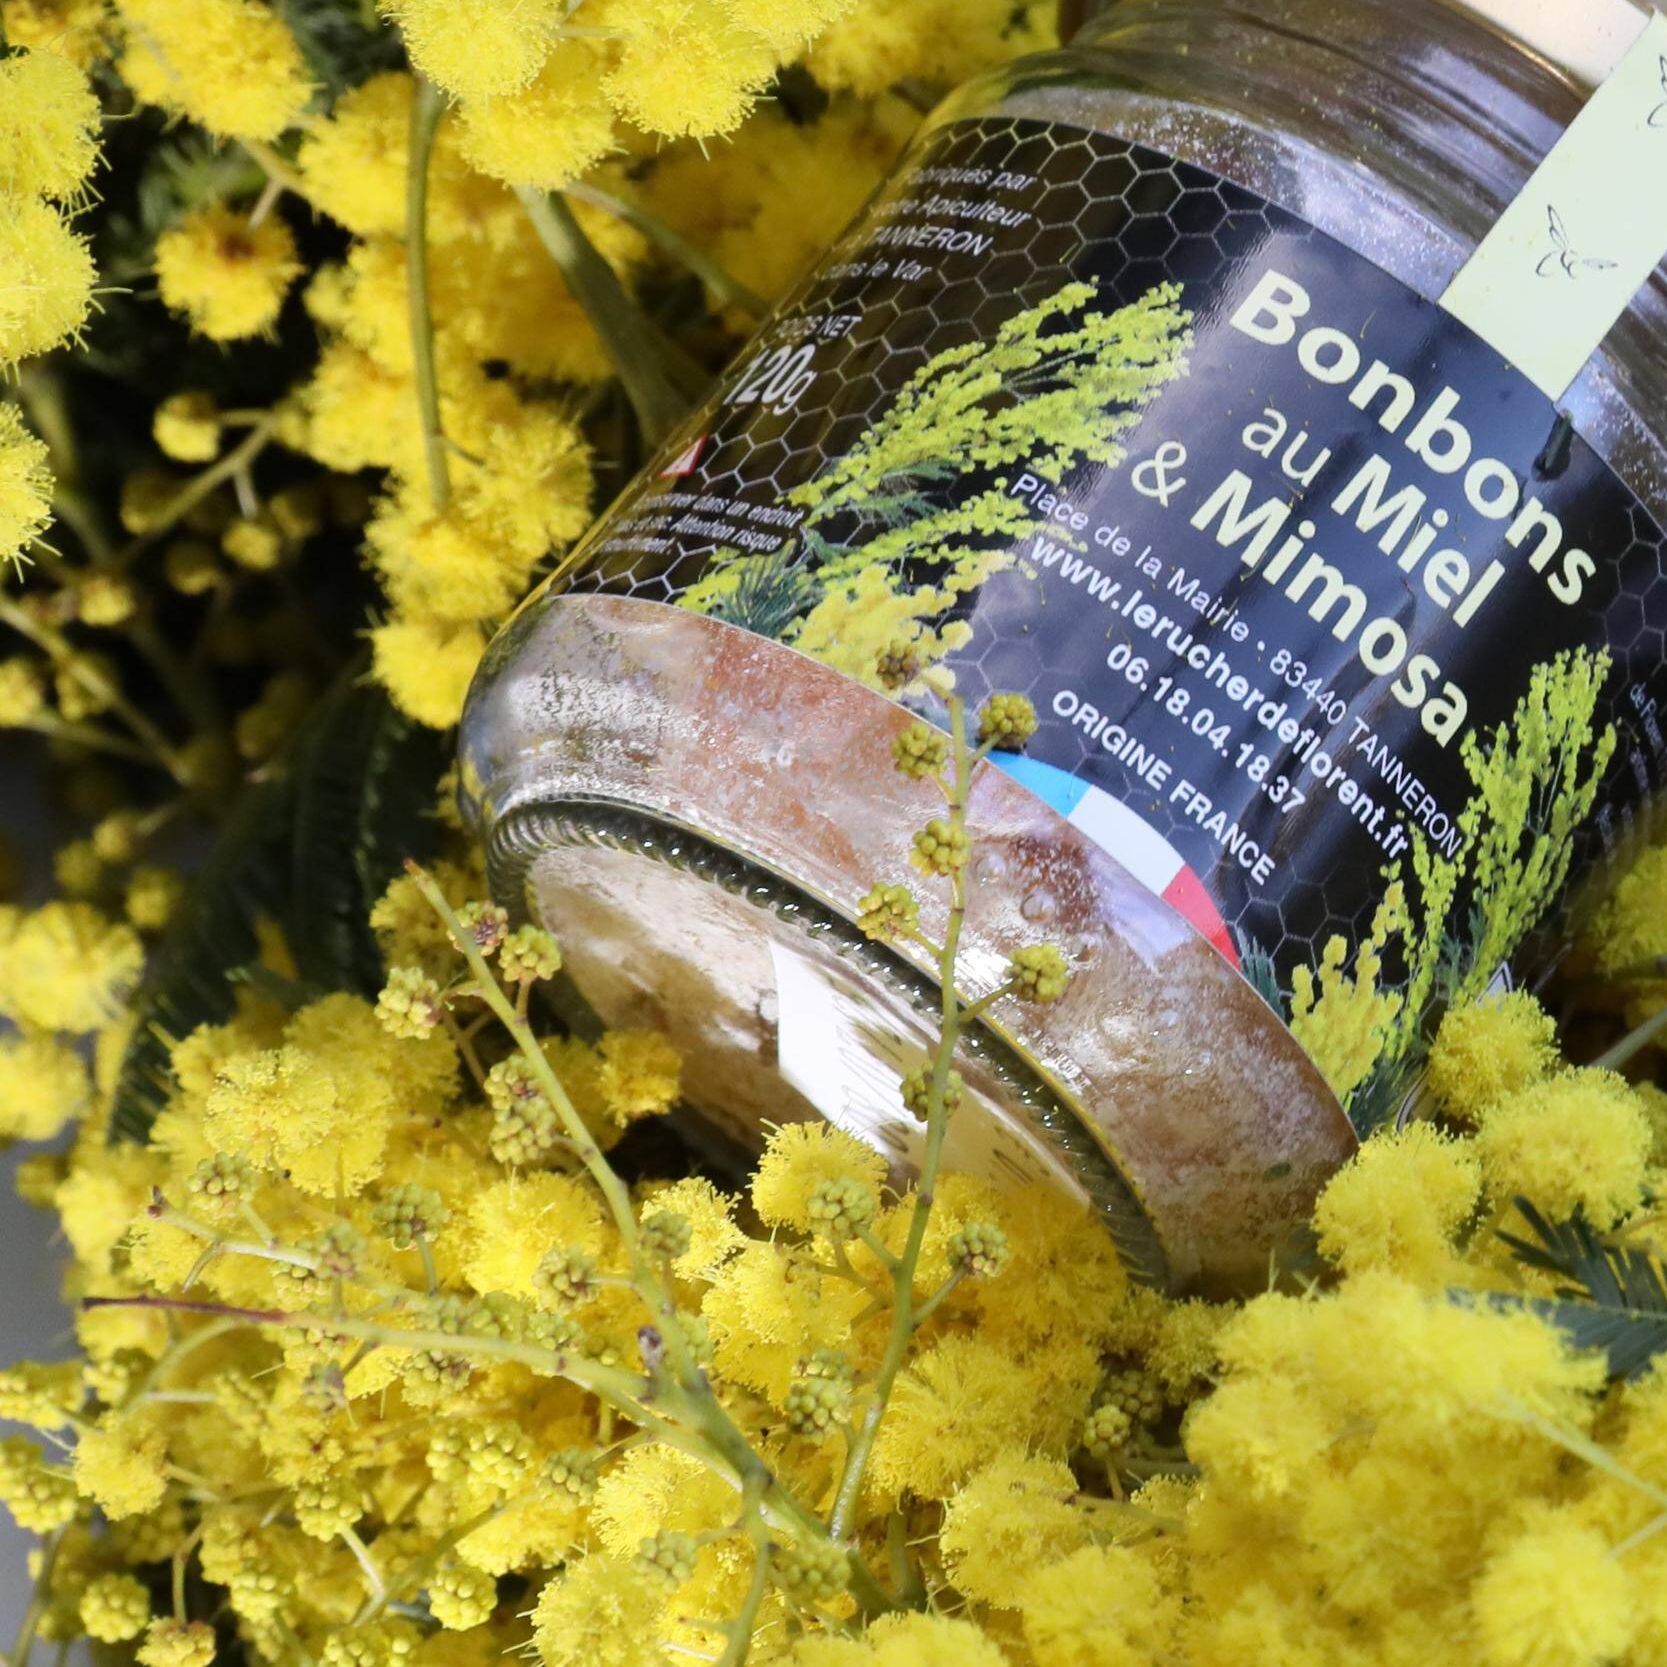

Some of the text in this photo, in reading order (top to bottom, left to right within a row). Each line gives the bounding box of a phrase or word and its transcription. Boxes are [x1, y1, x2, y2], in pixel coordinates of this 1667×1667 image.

[915, 193, 1032, 229] Apiculteur
[986, 170, 1038, 192] par
[866, 225, 993, 257] TANNERON
[866, 257, 889, 278] le
[892, 257, 933, 281] Var
[816, 315, 863, 338] NET
[722, 343, 818, 417] 120g
[1229, 269, 1596, 606] Bonbons
[669, 512, 737, 541] Attention
[731, 525, 783, 555] risque
[692, 491, 730, 513] dans
[726, 499, 750, 518] un
[747, 503, 805, 529] endroit
[1241, 406, 1505, 629] au Miel
[1131, 440, 1469, 748] & Mimosa
[1010, 472, 1464, 859] Place de la Mairie 83440 TANNERON
[1029, 534, 1411, 862] www.lerucherdeflorent.fr
[1106, 642, 1307, 817] 06.18.04.18.37
[1051, 688, 1277, 888] ORIGINE FRANCE
